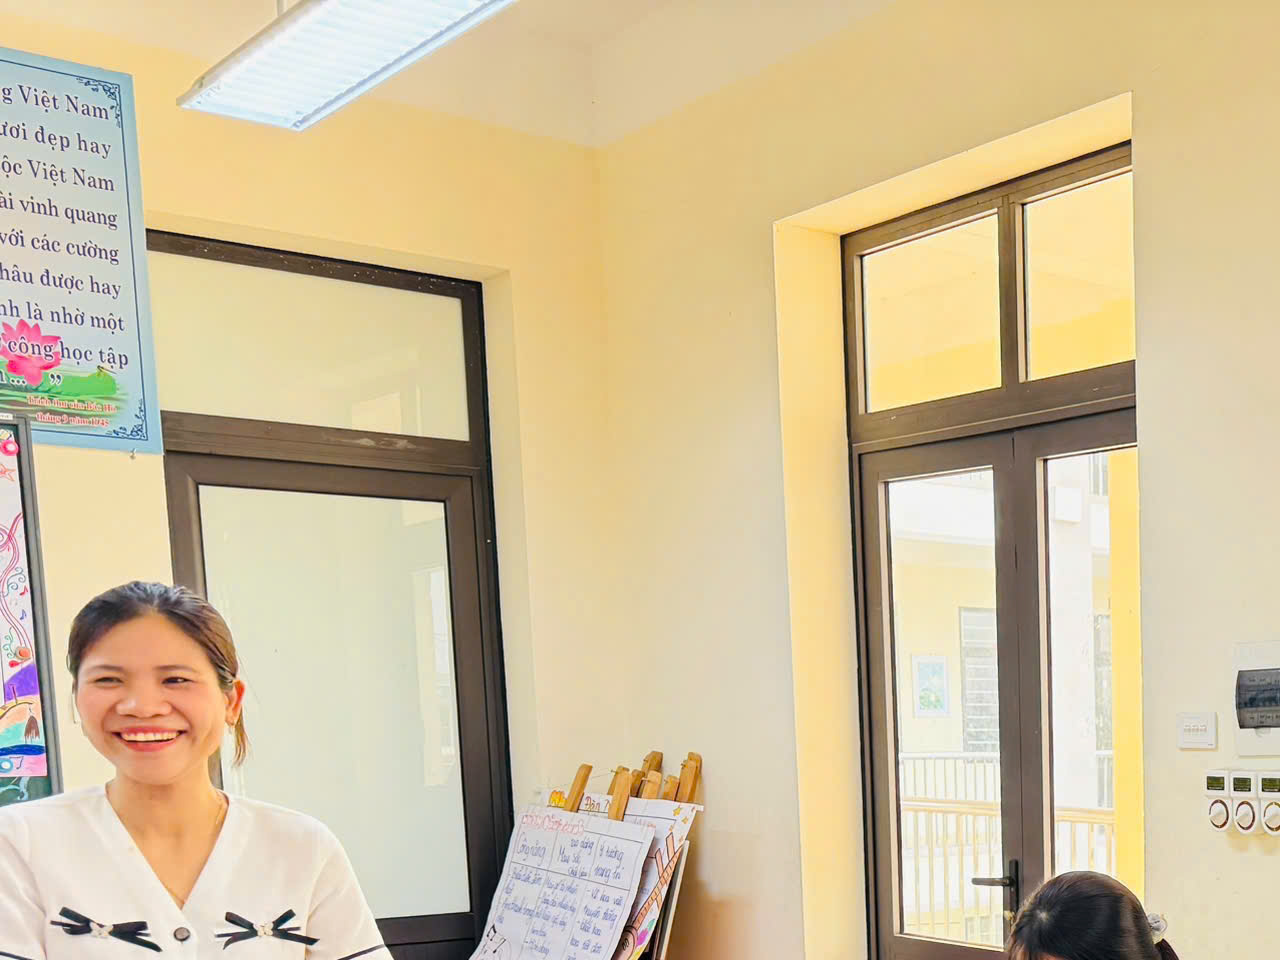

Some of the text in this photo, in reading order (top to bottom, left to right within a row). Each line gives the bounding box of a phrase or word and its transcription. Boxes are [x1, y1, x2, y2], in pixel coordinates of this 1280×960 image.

[17, 84, 59, 113] Việt
[65, 94, 109, 120] Nam
[35, 125, 70, 152] đẹp
[76, 132, 111, 160] hay
[27, 159, 67, 187] Việt
[72, 167, 115, 192] Nam
[19, 195, 60, 218] vinh
[64, 207, 118, 231] quang
[31, 233, 61, 253] các
[66, 240, 120, 266] cường
[40, 268, 84, 295] được
[89, 275, 121, 300] hay
[26, 301, 44, 322] là
[50, 306, 85, 327] nhờ
[90, 312, 125, 335] một
[8, 336, 129, 370] công học tập
